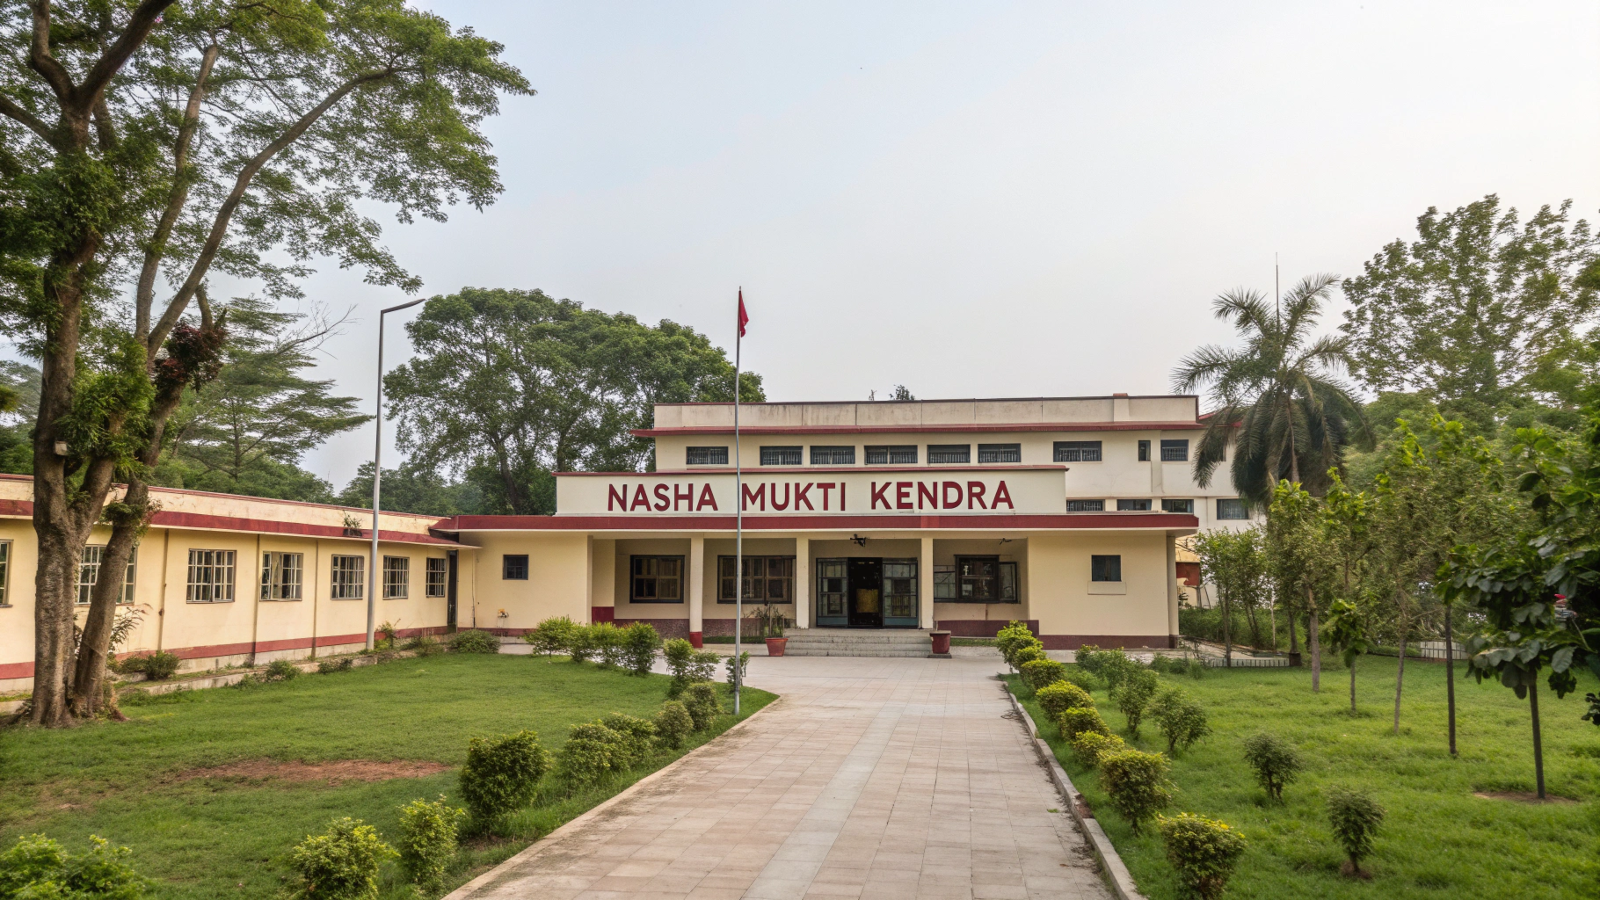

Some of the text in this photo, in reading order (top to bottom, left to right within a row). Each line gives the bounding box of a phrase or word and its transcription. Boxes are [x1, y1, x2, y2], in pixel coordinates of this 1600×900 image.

[607, 480, 1014, 512] NASHA MUKTI KENDRA
